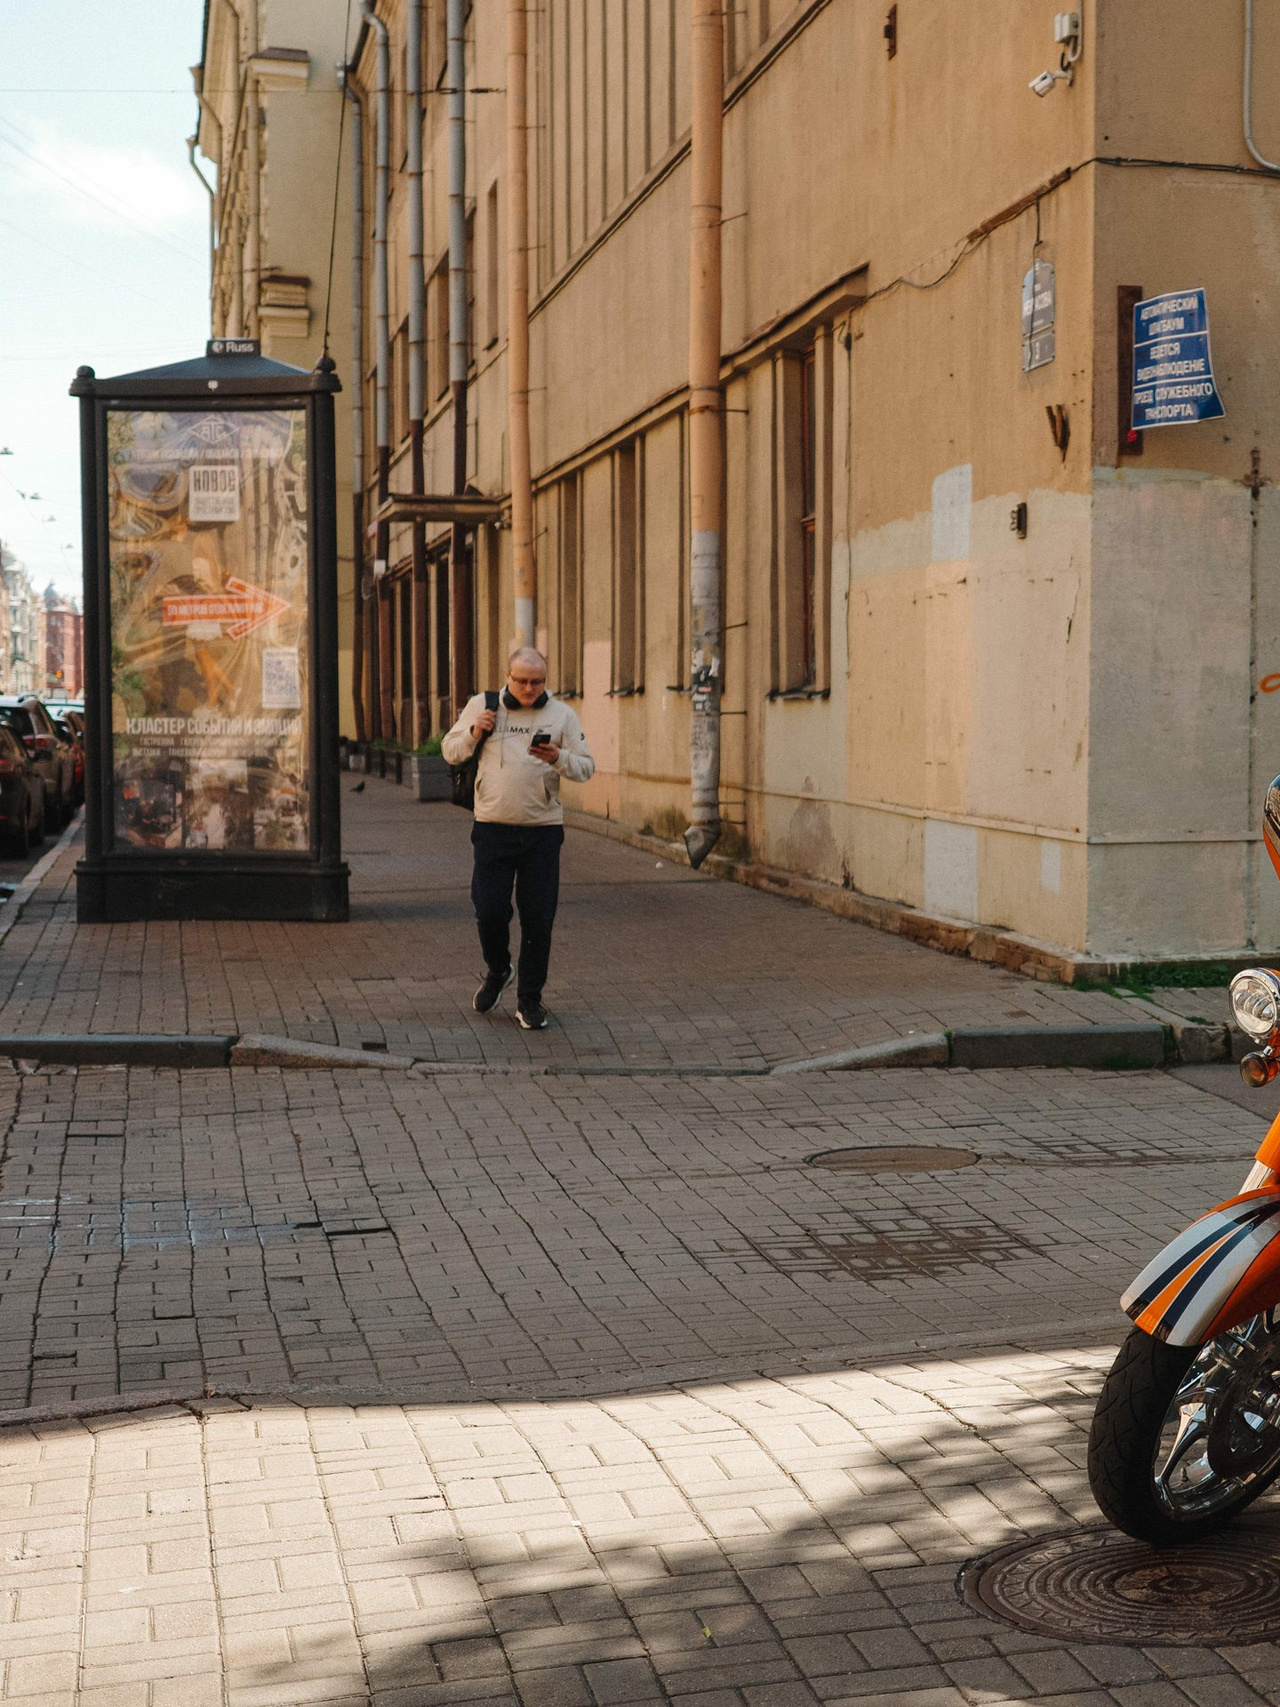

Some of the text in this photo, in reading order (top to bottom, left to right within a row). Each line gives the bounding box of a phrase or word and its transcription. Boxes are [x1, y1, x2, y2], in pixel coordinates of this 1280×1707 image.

[226, 341, 254, 353] Russ
[1150, 342, 1181, 360] ВЕДЕТСЯ
[1155, 382, 1213, 401] СЛУЖЕБНОГО
[193, 470, 236, 492] НОВОЕ
[126, 717, 184, 735] КЛАСТЕР
[187, 717, 242, 735] СОБЫТИЙ
[244, 717, 253, 735] И
